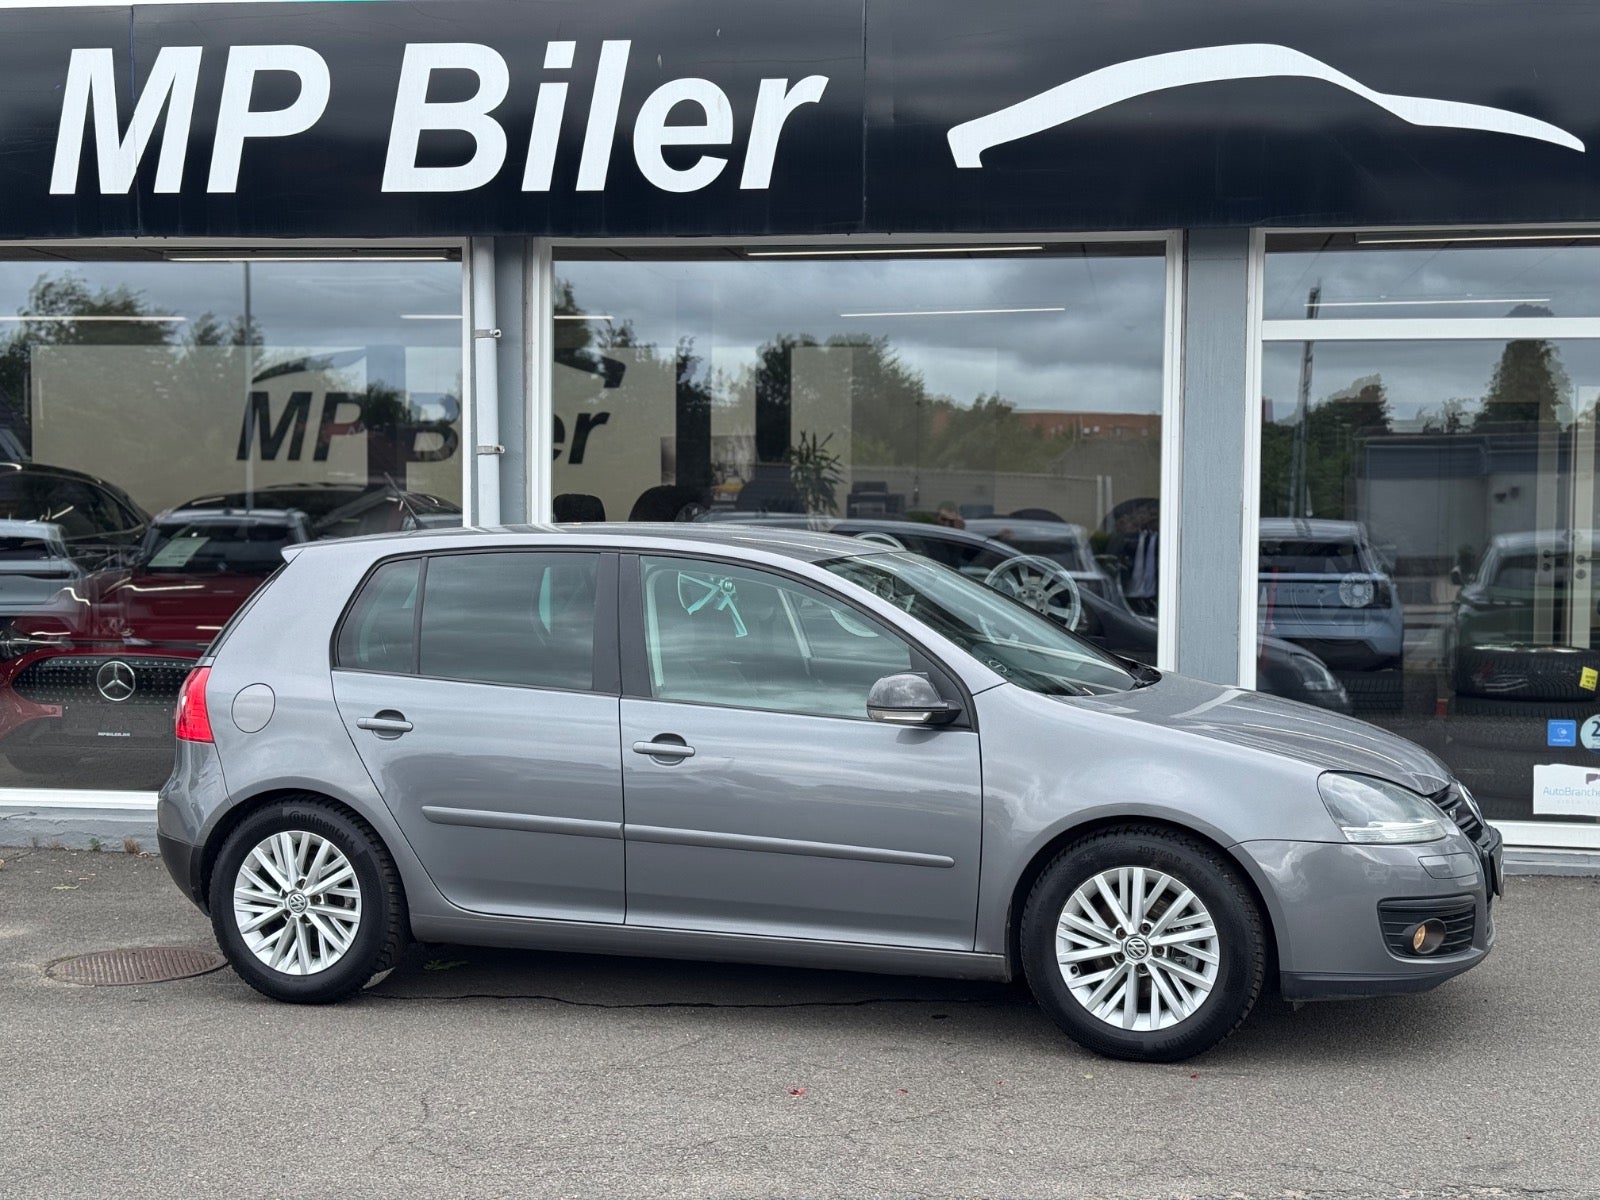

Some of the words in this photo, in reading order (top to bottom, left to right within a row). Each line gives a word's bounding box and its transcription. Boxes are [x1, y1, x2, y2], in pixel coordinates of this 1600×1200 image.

[49, 44, 331, 196] MP
[381, 39, 830, 193] Biler
[236, 390, 367, 463] MP
